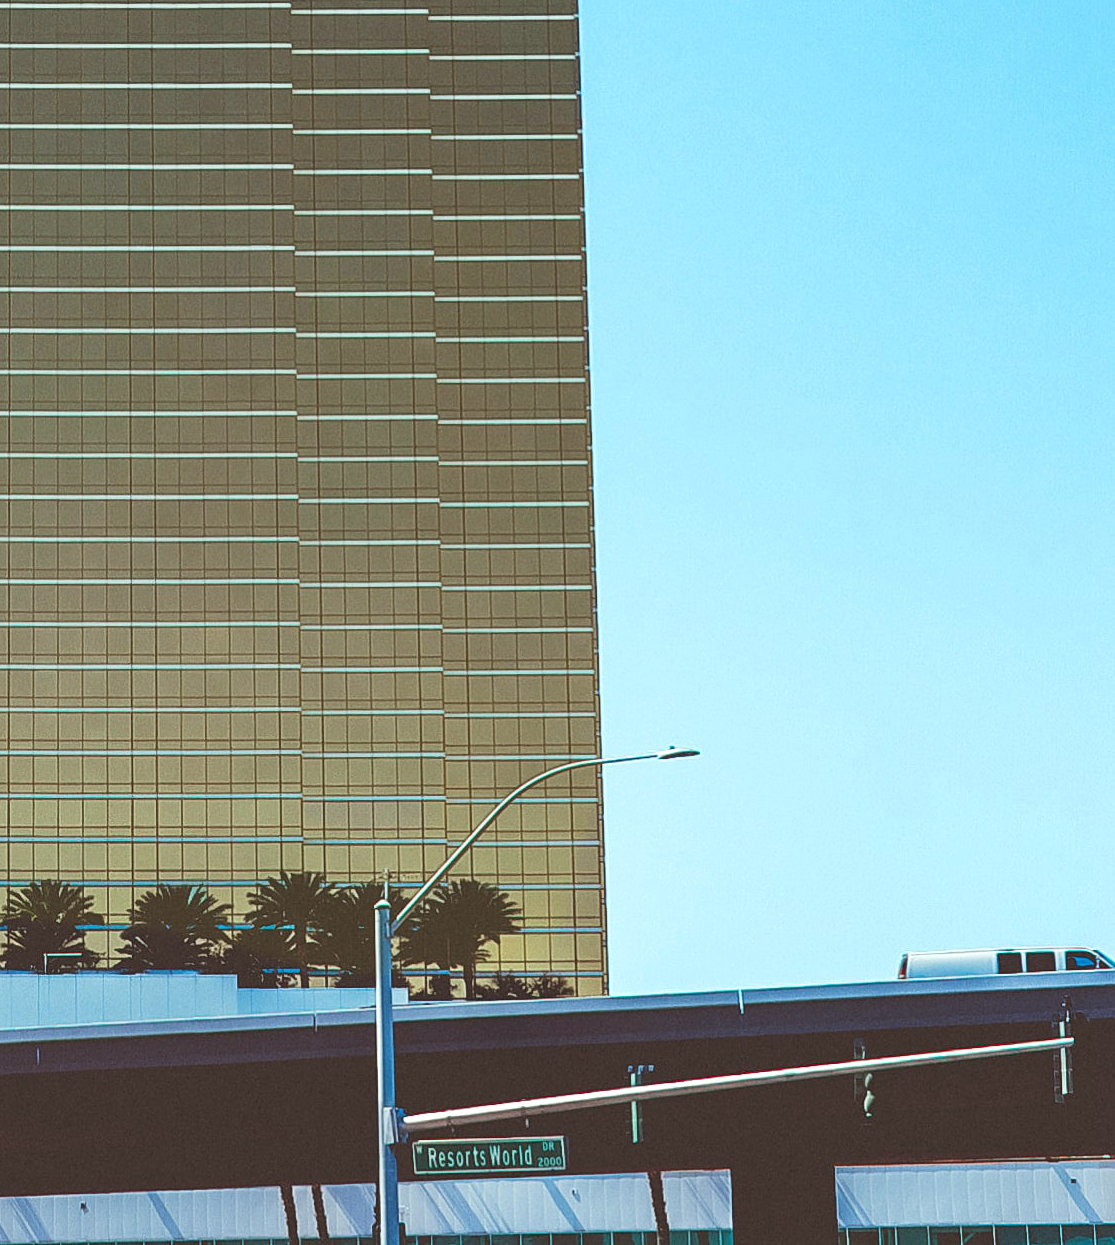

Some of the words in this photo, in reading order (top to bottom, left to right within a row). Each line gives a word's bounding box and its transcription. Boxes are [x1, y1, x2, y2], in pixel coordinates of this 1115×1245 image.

[416, 1146, 422, 1154] W
[427, 1146, 485, 1169] Resorts
[489, 1145, 533, 1167] World
[542, 1142, 555, 1152] DR
[537, 1156, 562, 1167] 2000
